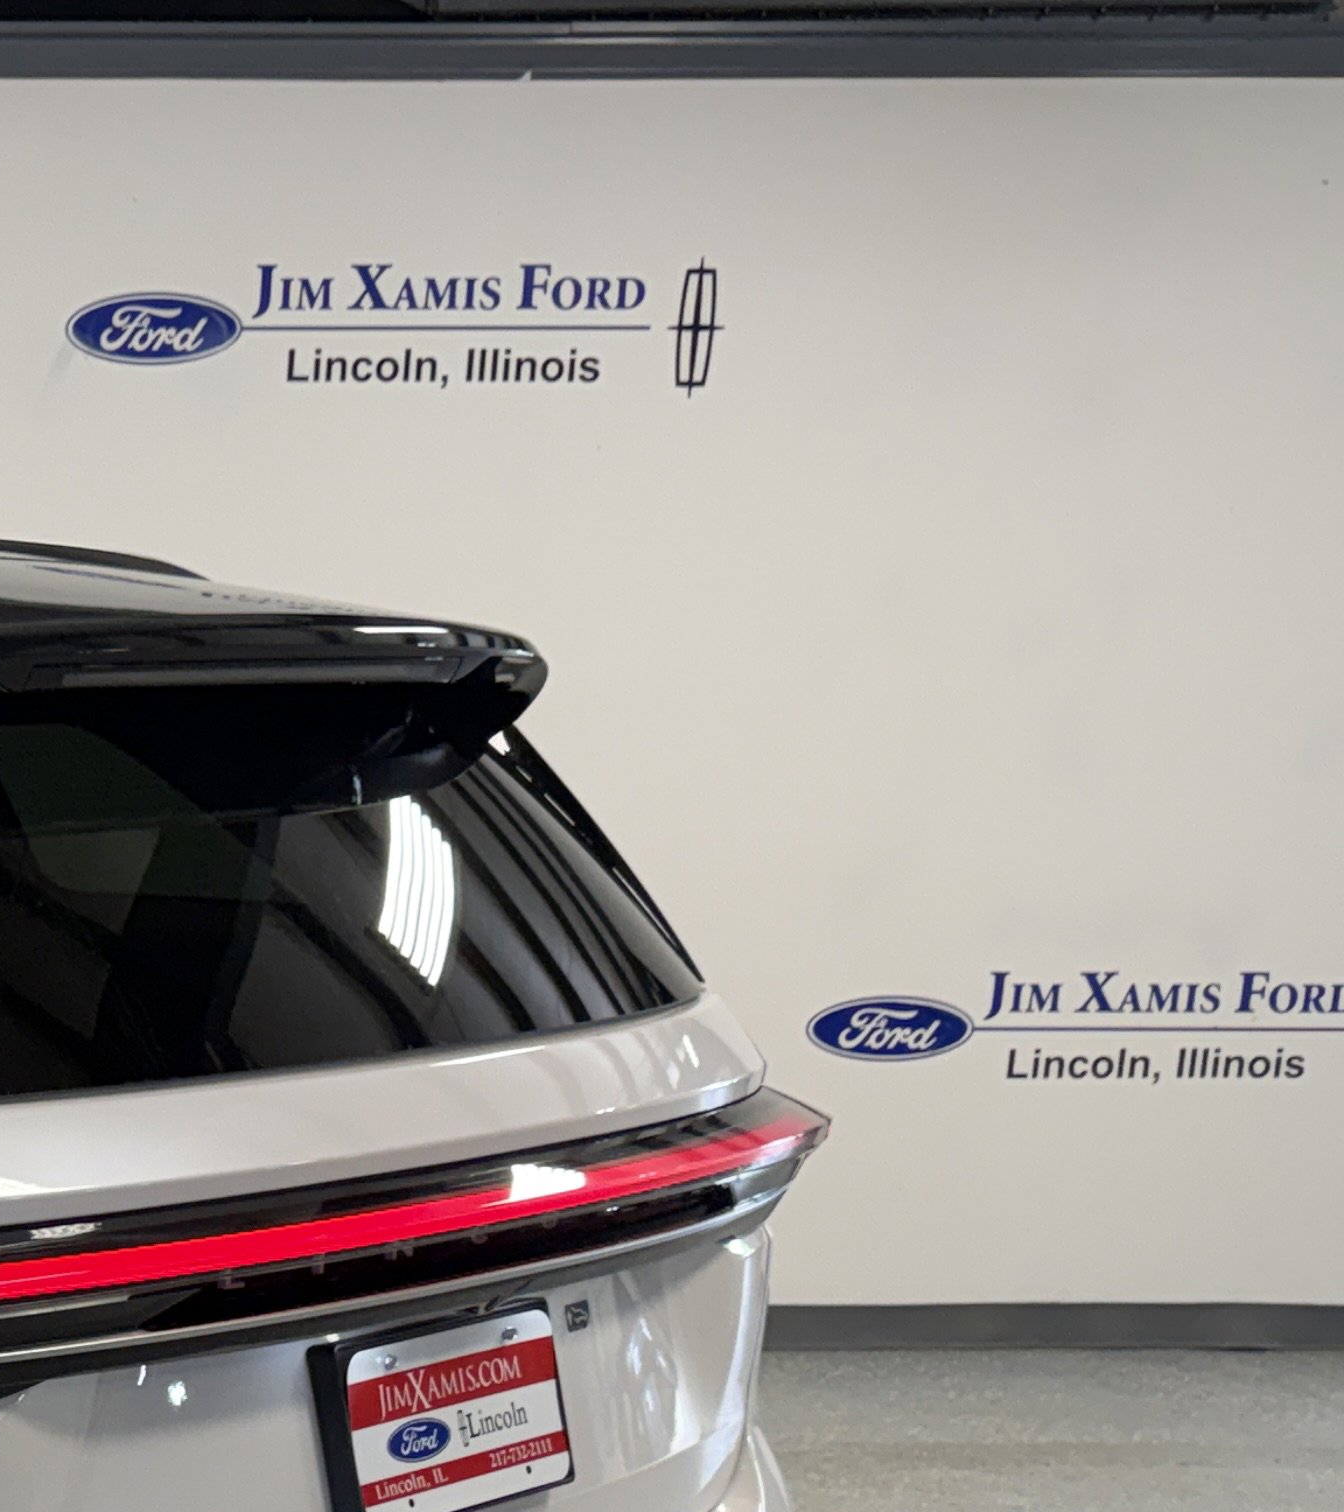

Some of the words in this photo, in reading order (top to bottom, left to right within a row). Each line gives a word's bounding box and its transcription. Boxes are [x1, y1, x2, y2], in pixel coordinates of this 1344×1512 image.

[252, 263, 334, 319] JIM
[347, 264, 502, 310] XAMIS
[516, 264, 647, 311] FORD
[99, 304, 206, 353] Ford
[285, 348, 450, 388] Lincoln,
[465, 350, 601, 384] Illinois
[983, 971, 1064, 1020] JIM
[1074, 971, 1220, 1014] XAMIS
[837, 1007, 938, 1050] Ford
[1005, 1047, 1162, 1085] Lincoln,
[1175, 1048, 1306, 1080] Illinois
[400, 1425, 438, 1456] Ford
[465, 1402, 528, 1439] Lincoln
[375, 1472, 431, 1500] Lincoln,
[434, 1468, 448, 1484] IL
